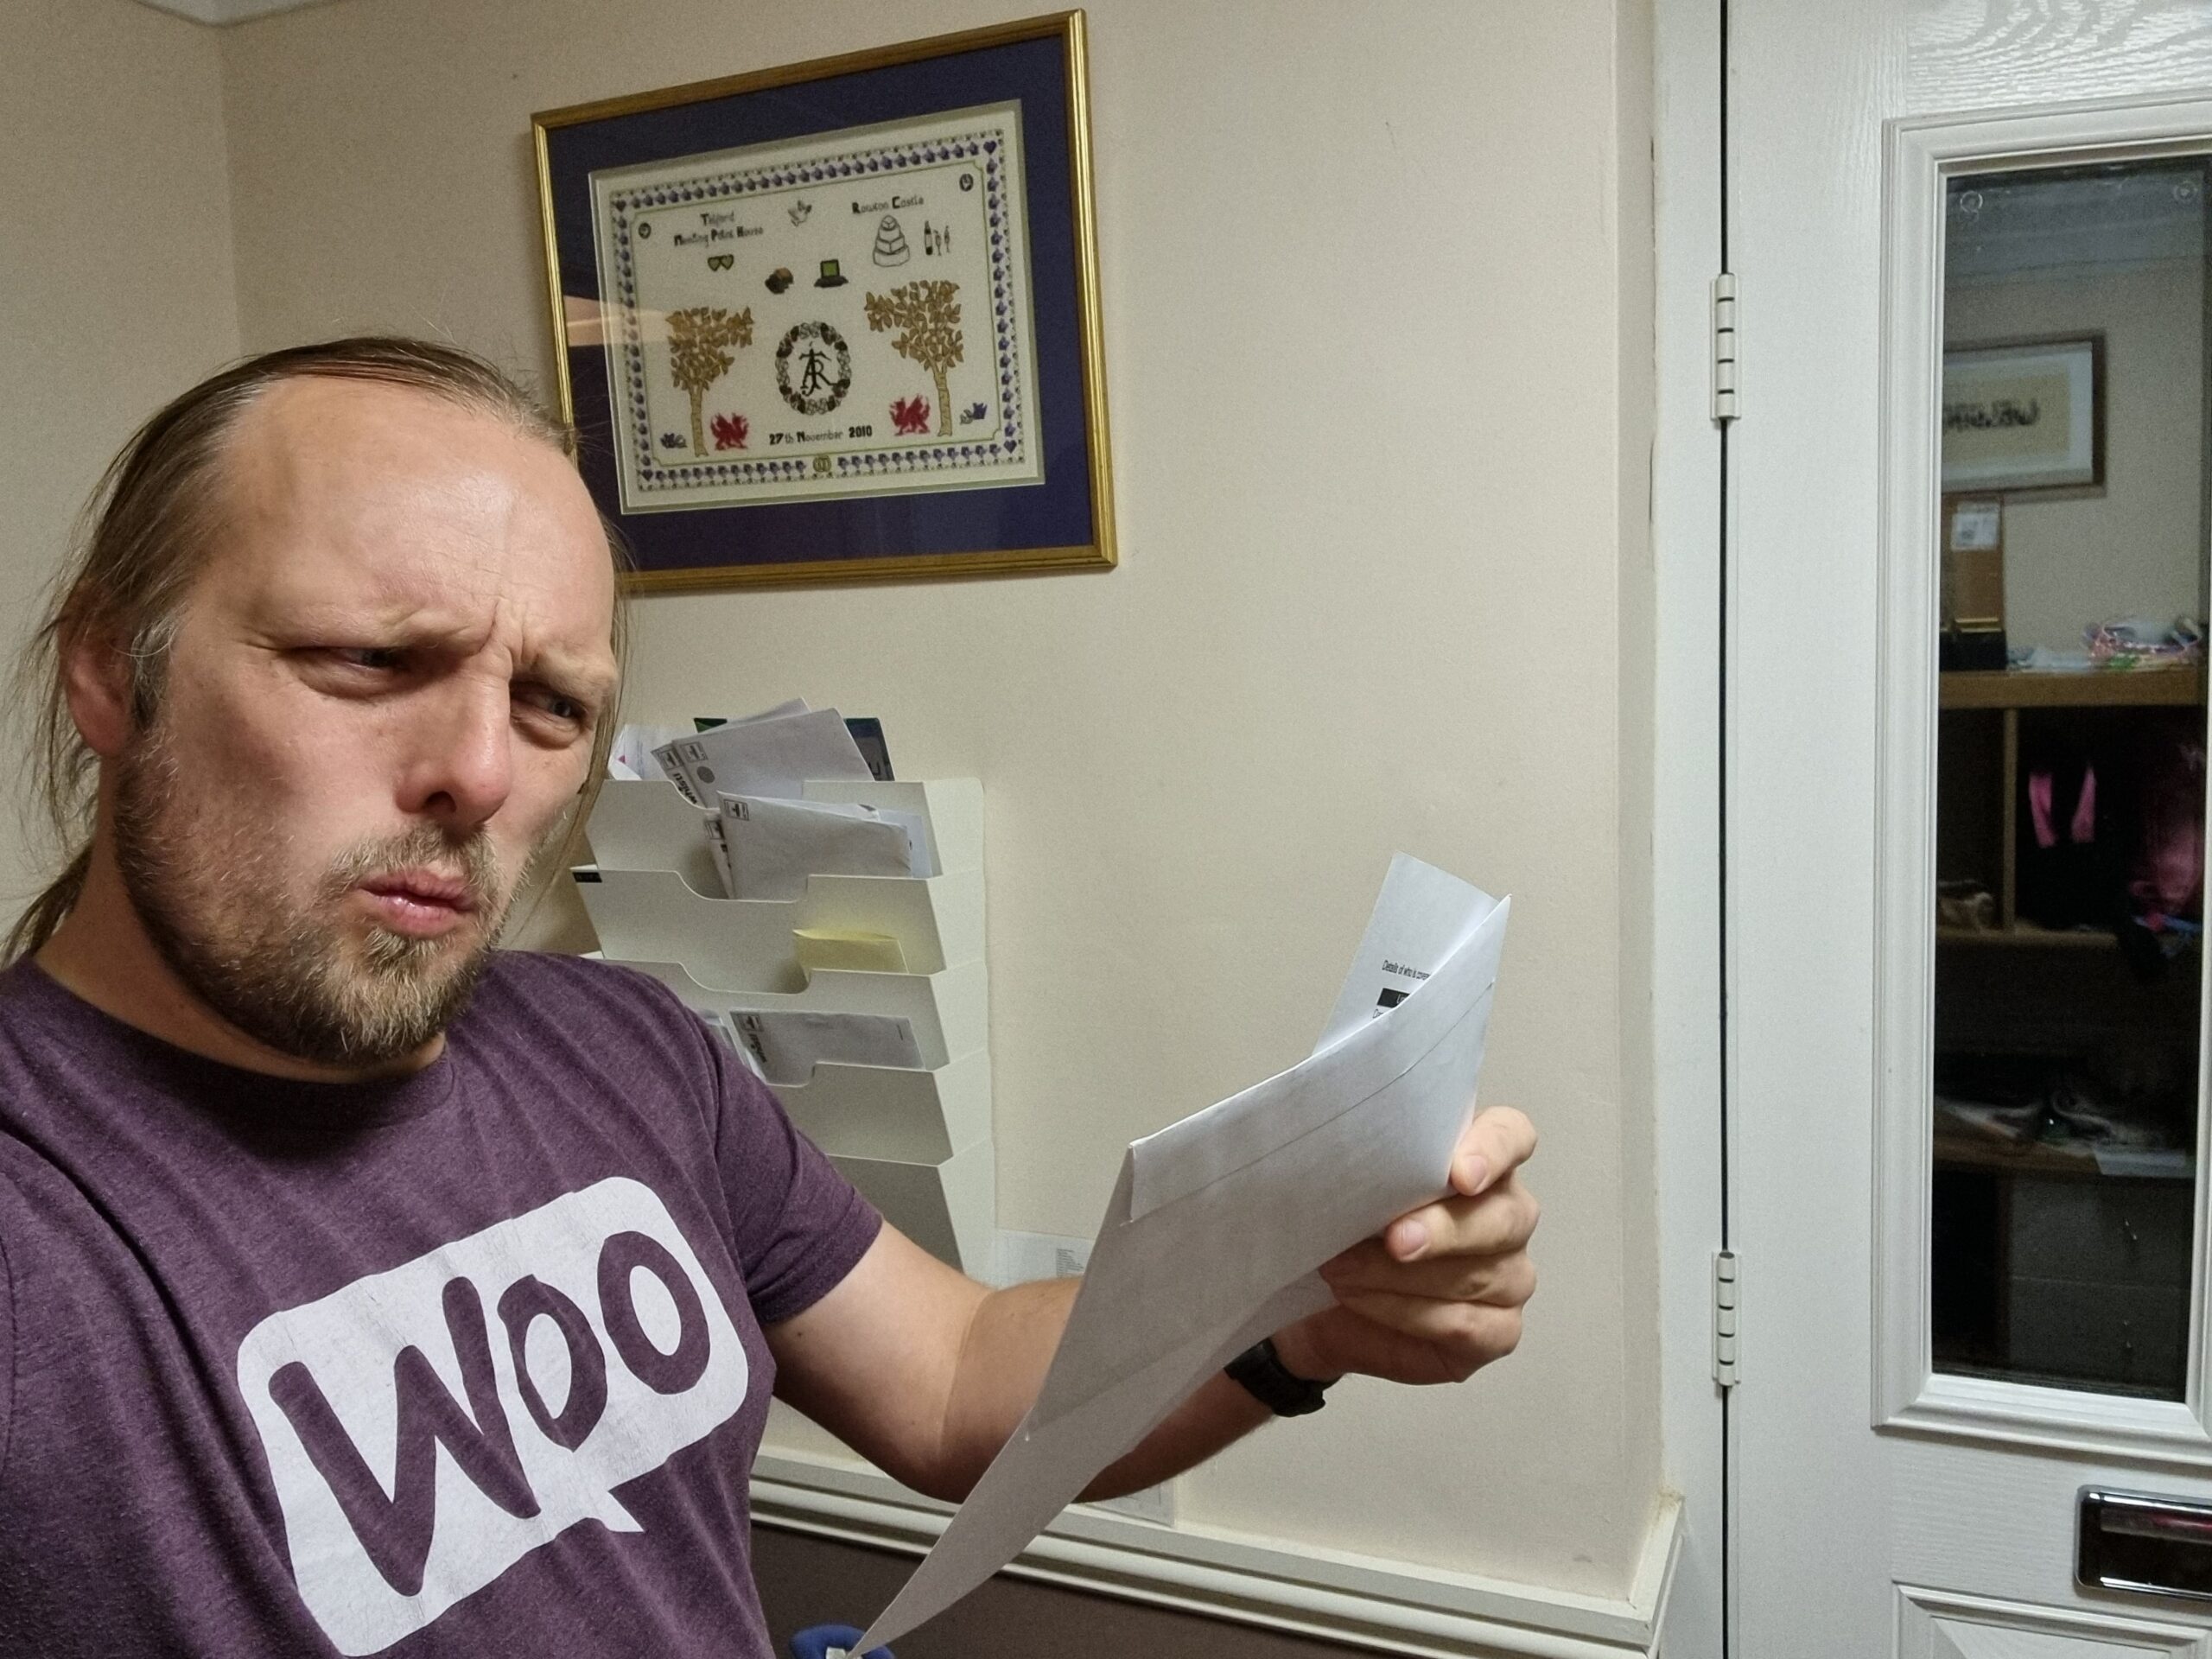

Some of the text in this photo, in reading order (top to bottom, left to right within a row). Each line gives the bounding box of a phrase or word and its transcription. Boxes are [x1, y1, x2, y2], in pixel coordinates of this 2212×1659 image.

[892, 195, 924, 209] Castle
[797, 430, 843, 443] November
[849, 425, 872, 438] 2010
